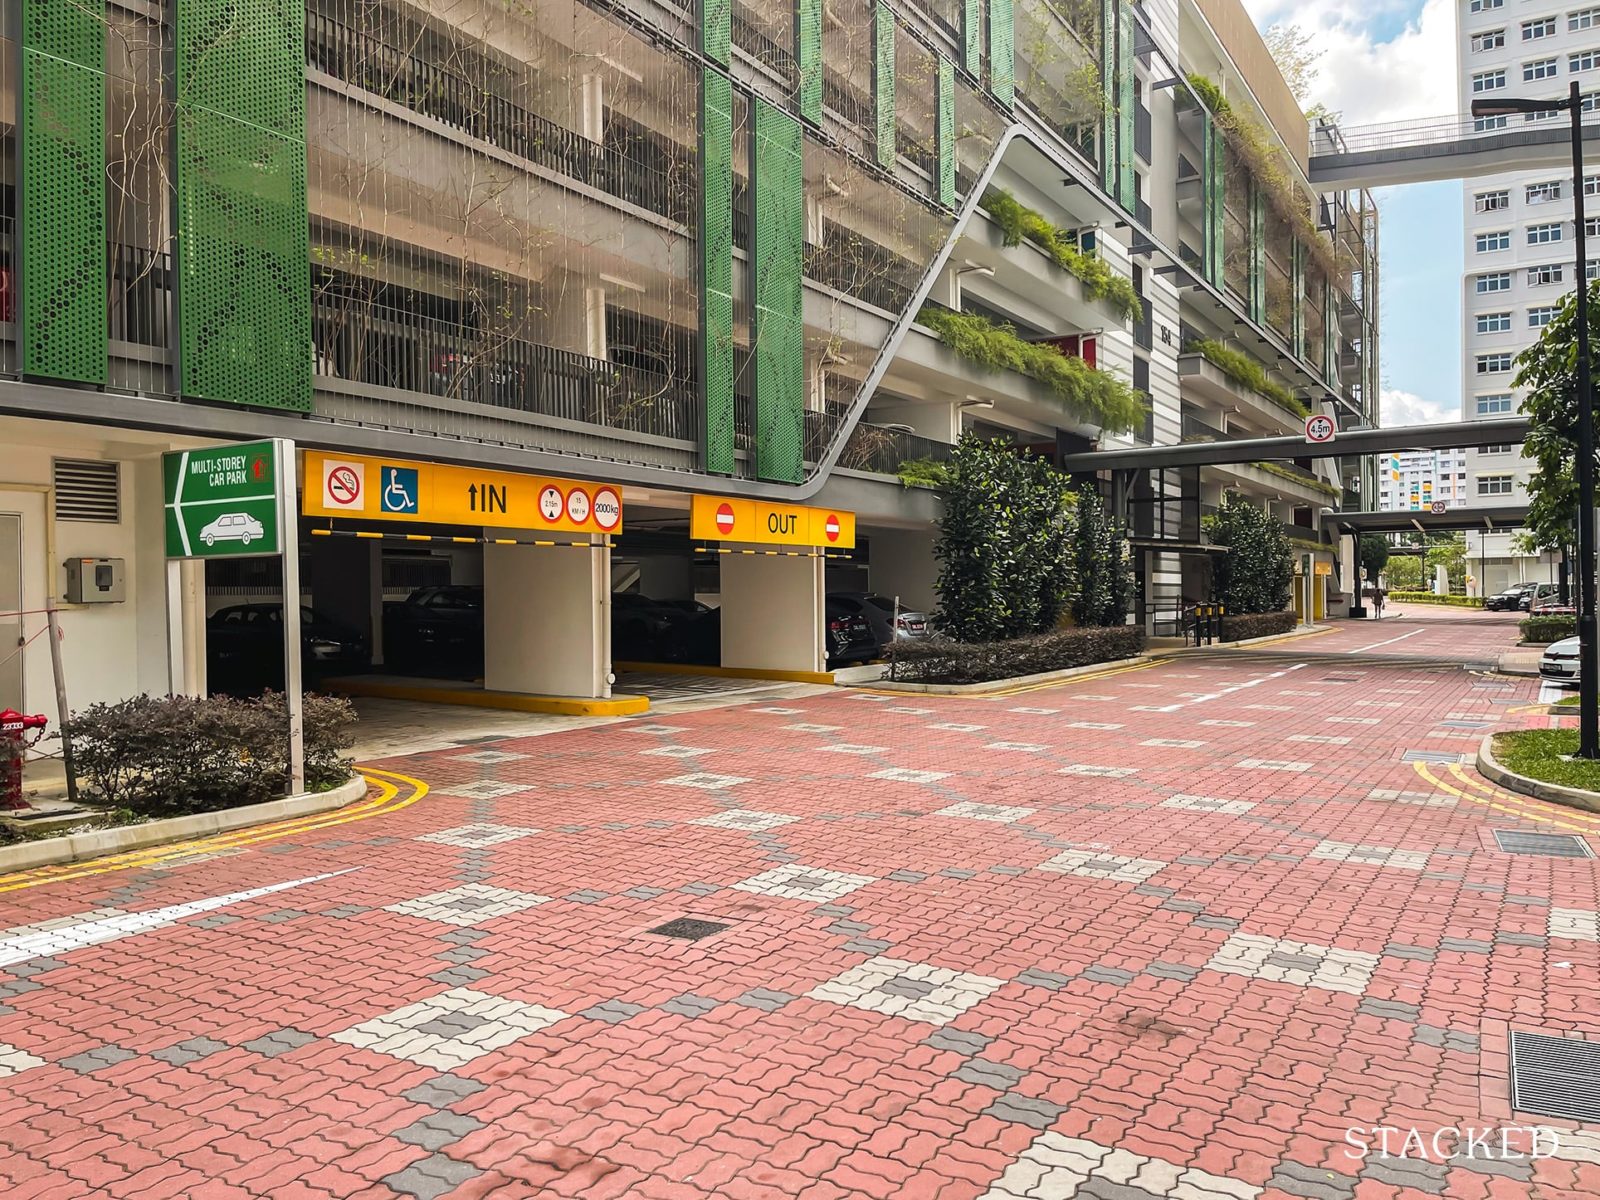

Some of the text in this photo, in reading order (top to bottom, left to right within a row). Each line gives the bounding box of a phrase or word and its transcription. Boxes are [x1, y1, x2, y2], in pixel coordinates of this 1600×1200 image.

[1160, 325, 1171, 346] 154
[1310, 424, 1330, 433] 4.5m
[191, 456, 247, 474] MULTI-STOREY
[209, 470, 247, 487] CAR PARK
[481, 483, 507, 513] IN
[545, 500, 559, 508] 2.15m
[768, 512, 797, 535] OUT
